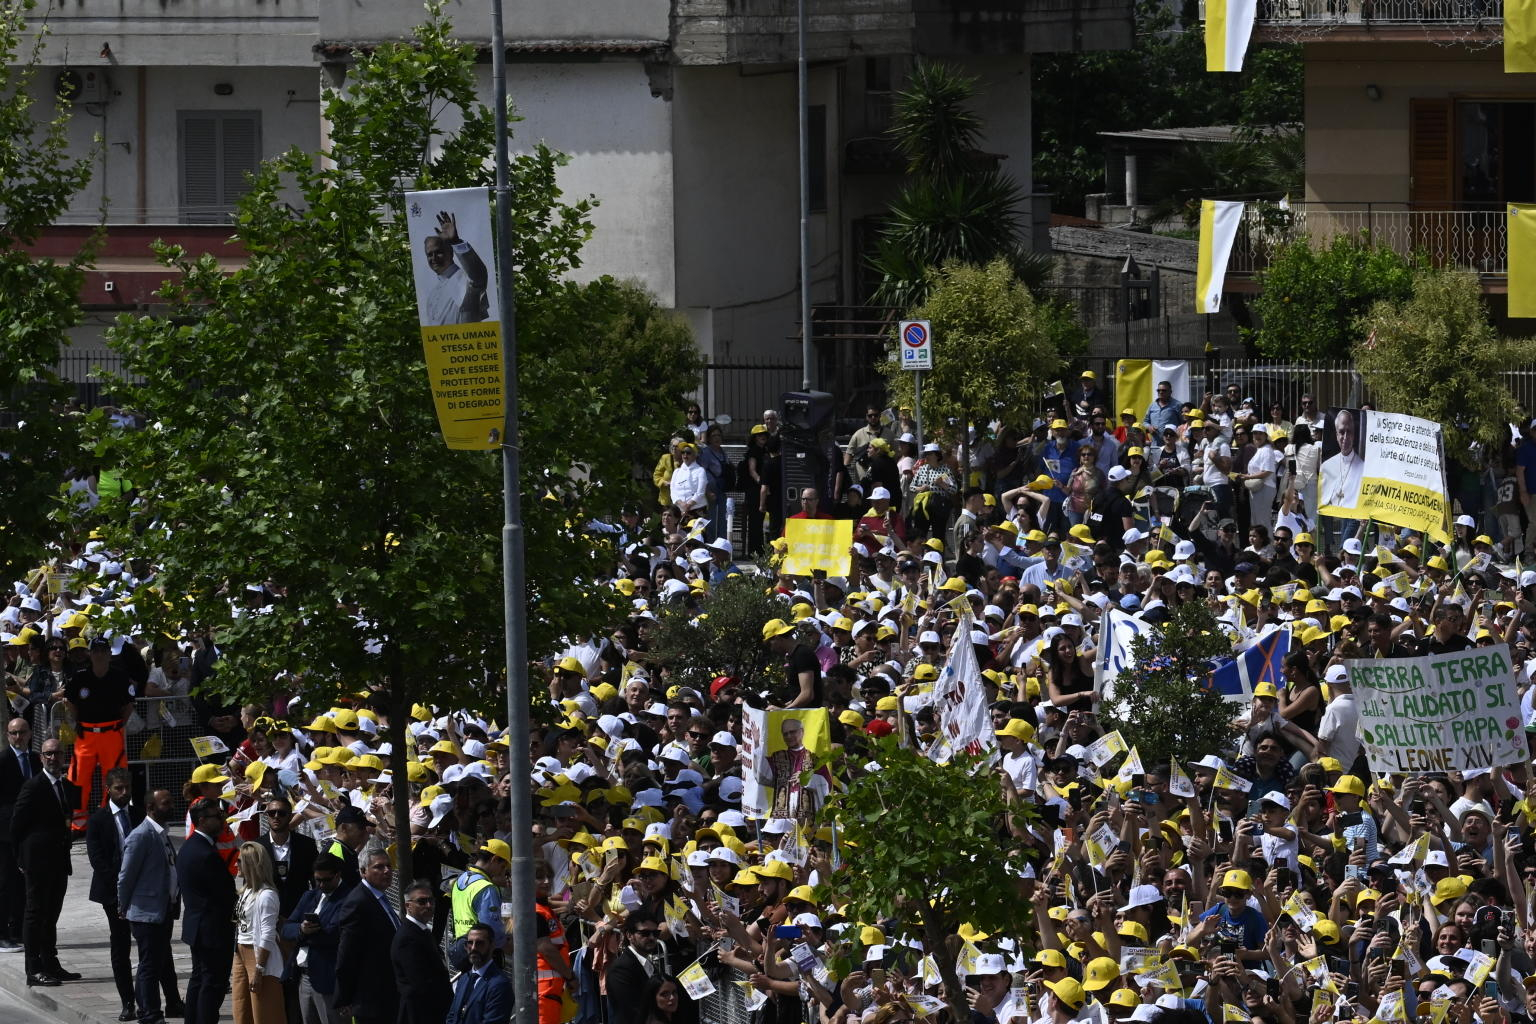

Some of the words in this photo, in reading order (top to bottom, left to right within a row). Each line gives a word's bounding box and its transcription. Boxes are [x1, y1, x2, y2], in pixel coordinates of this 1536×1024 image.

[440, 333, 460, 342] VITA
[462, 330, 497, 340] UMANA
[441, 344, 475, 353] STESSA
[484, 341, 498, 349] UN
[450, 354, 479, 363] DONO
[481, 353, 498, 361] CHE
[442, 366, 466, 375] DEVE
[468, 364, 499, 373] ESSERE
[440, 377, 486, 387] PROTETTO
[487, 376, 500, 384] DA
[436, 390, 469, 398] DIVERSE
[471, 387, 500, 397] FORME
[459, 399, 501, 409] DEGRADO
[1369, 433, 1385, 444] della
[1362, 483, 1369, 495] LE
[1385, 503, 1399, 513] SAN
[1431, 652, 1508, 685] TERRA
[1362, 701, 1385, 717] della
[1374, 723, 1442, 747] SALUTA
[1451, 716, 1503, 744] PAPA
[1395, 748, 1457, 771] LEONE
[1461, 744, 1493, 769] XIV
